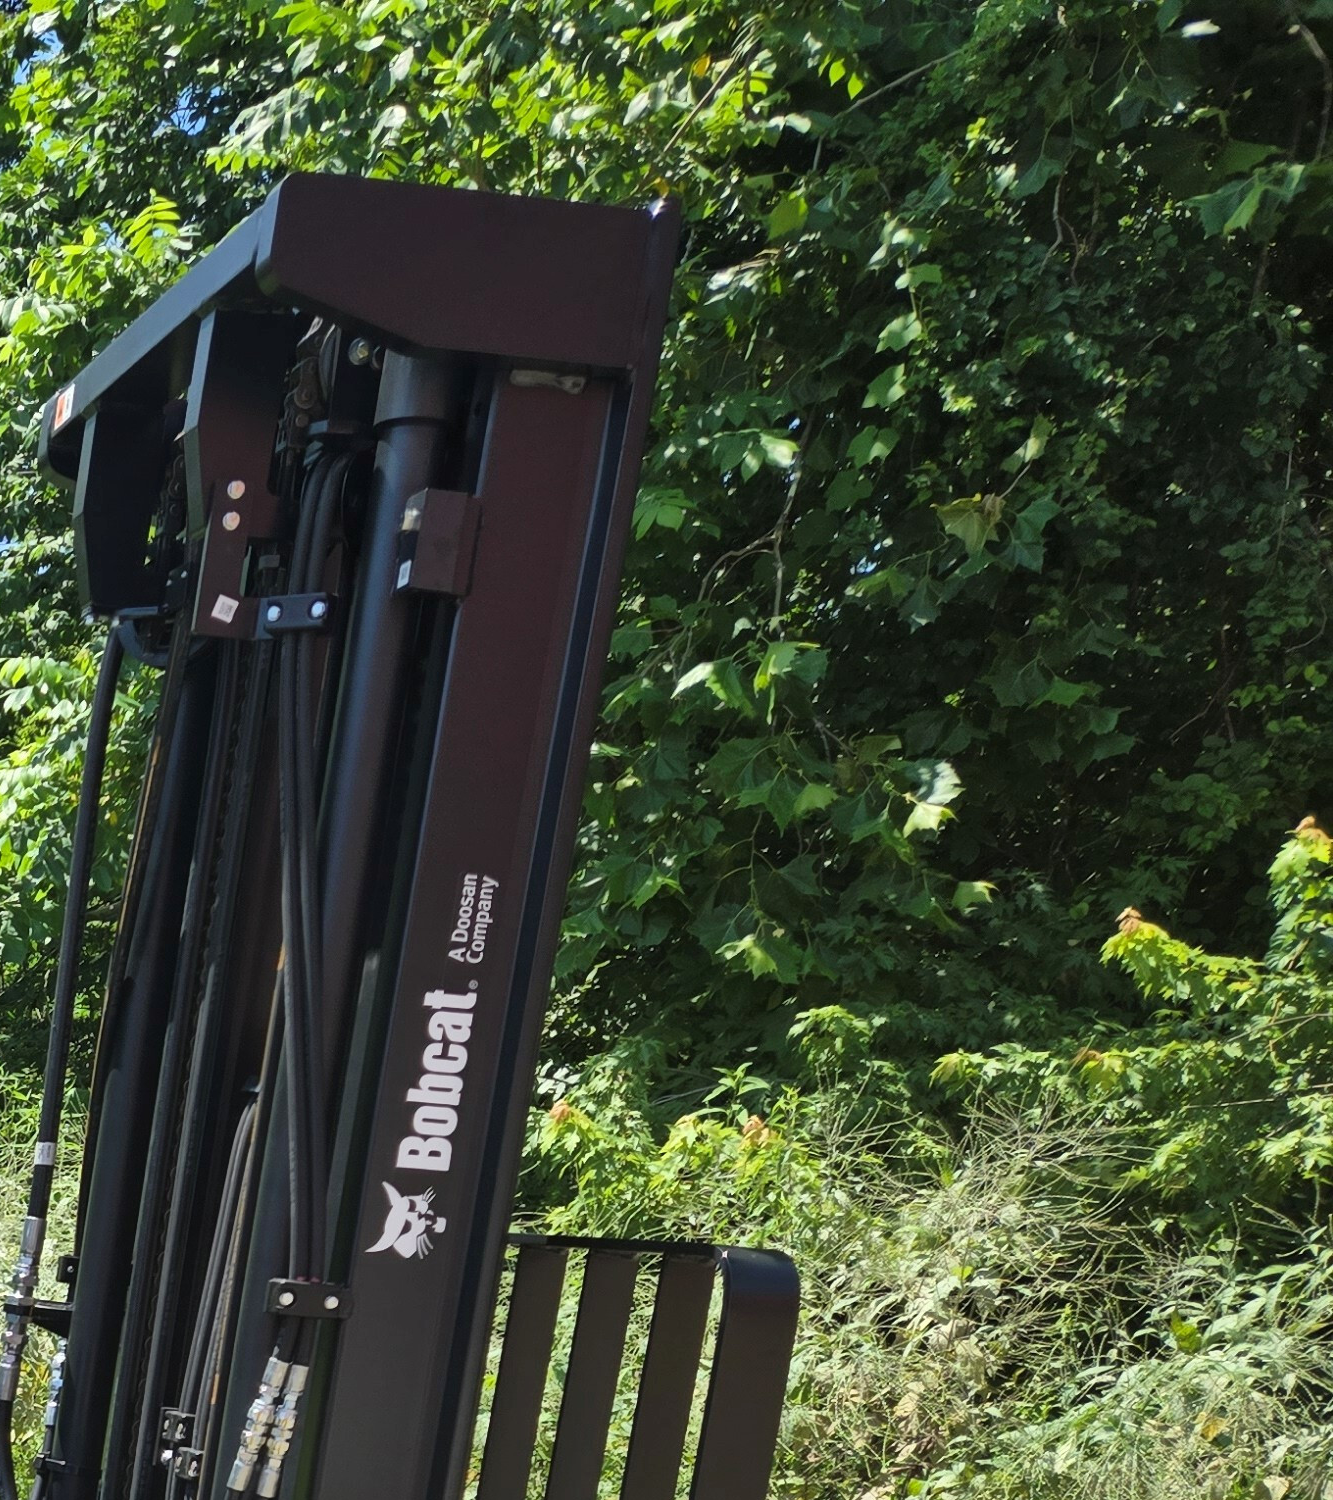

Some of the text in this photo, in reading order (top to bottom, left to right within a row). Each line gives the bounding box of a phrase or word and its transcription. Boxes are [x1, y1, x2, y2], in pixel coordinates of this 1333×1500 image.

[448, 873, 478, 962] A Doosan
[466, 875, 500, 964] Company
[395, 989, 478, 1172] Bobcat
